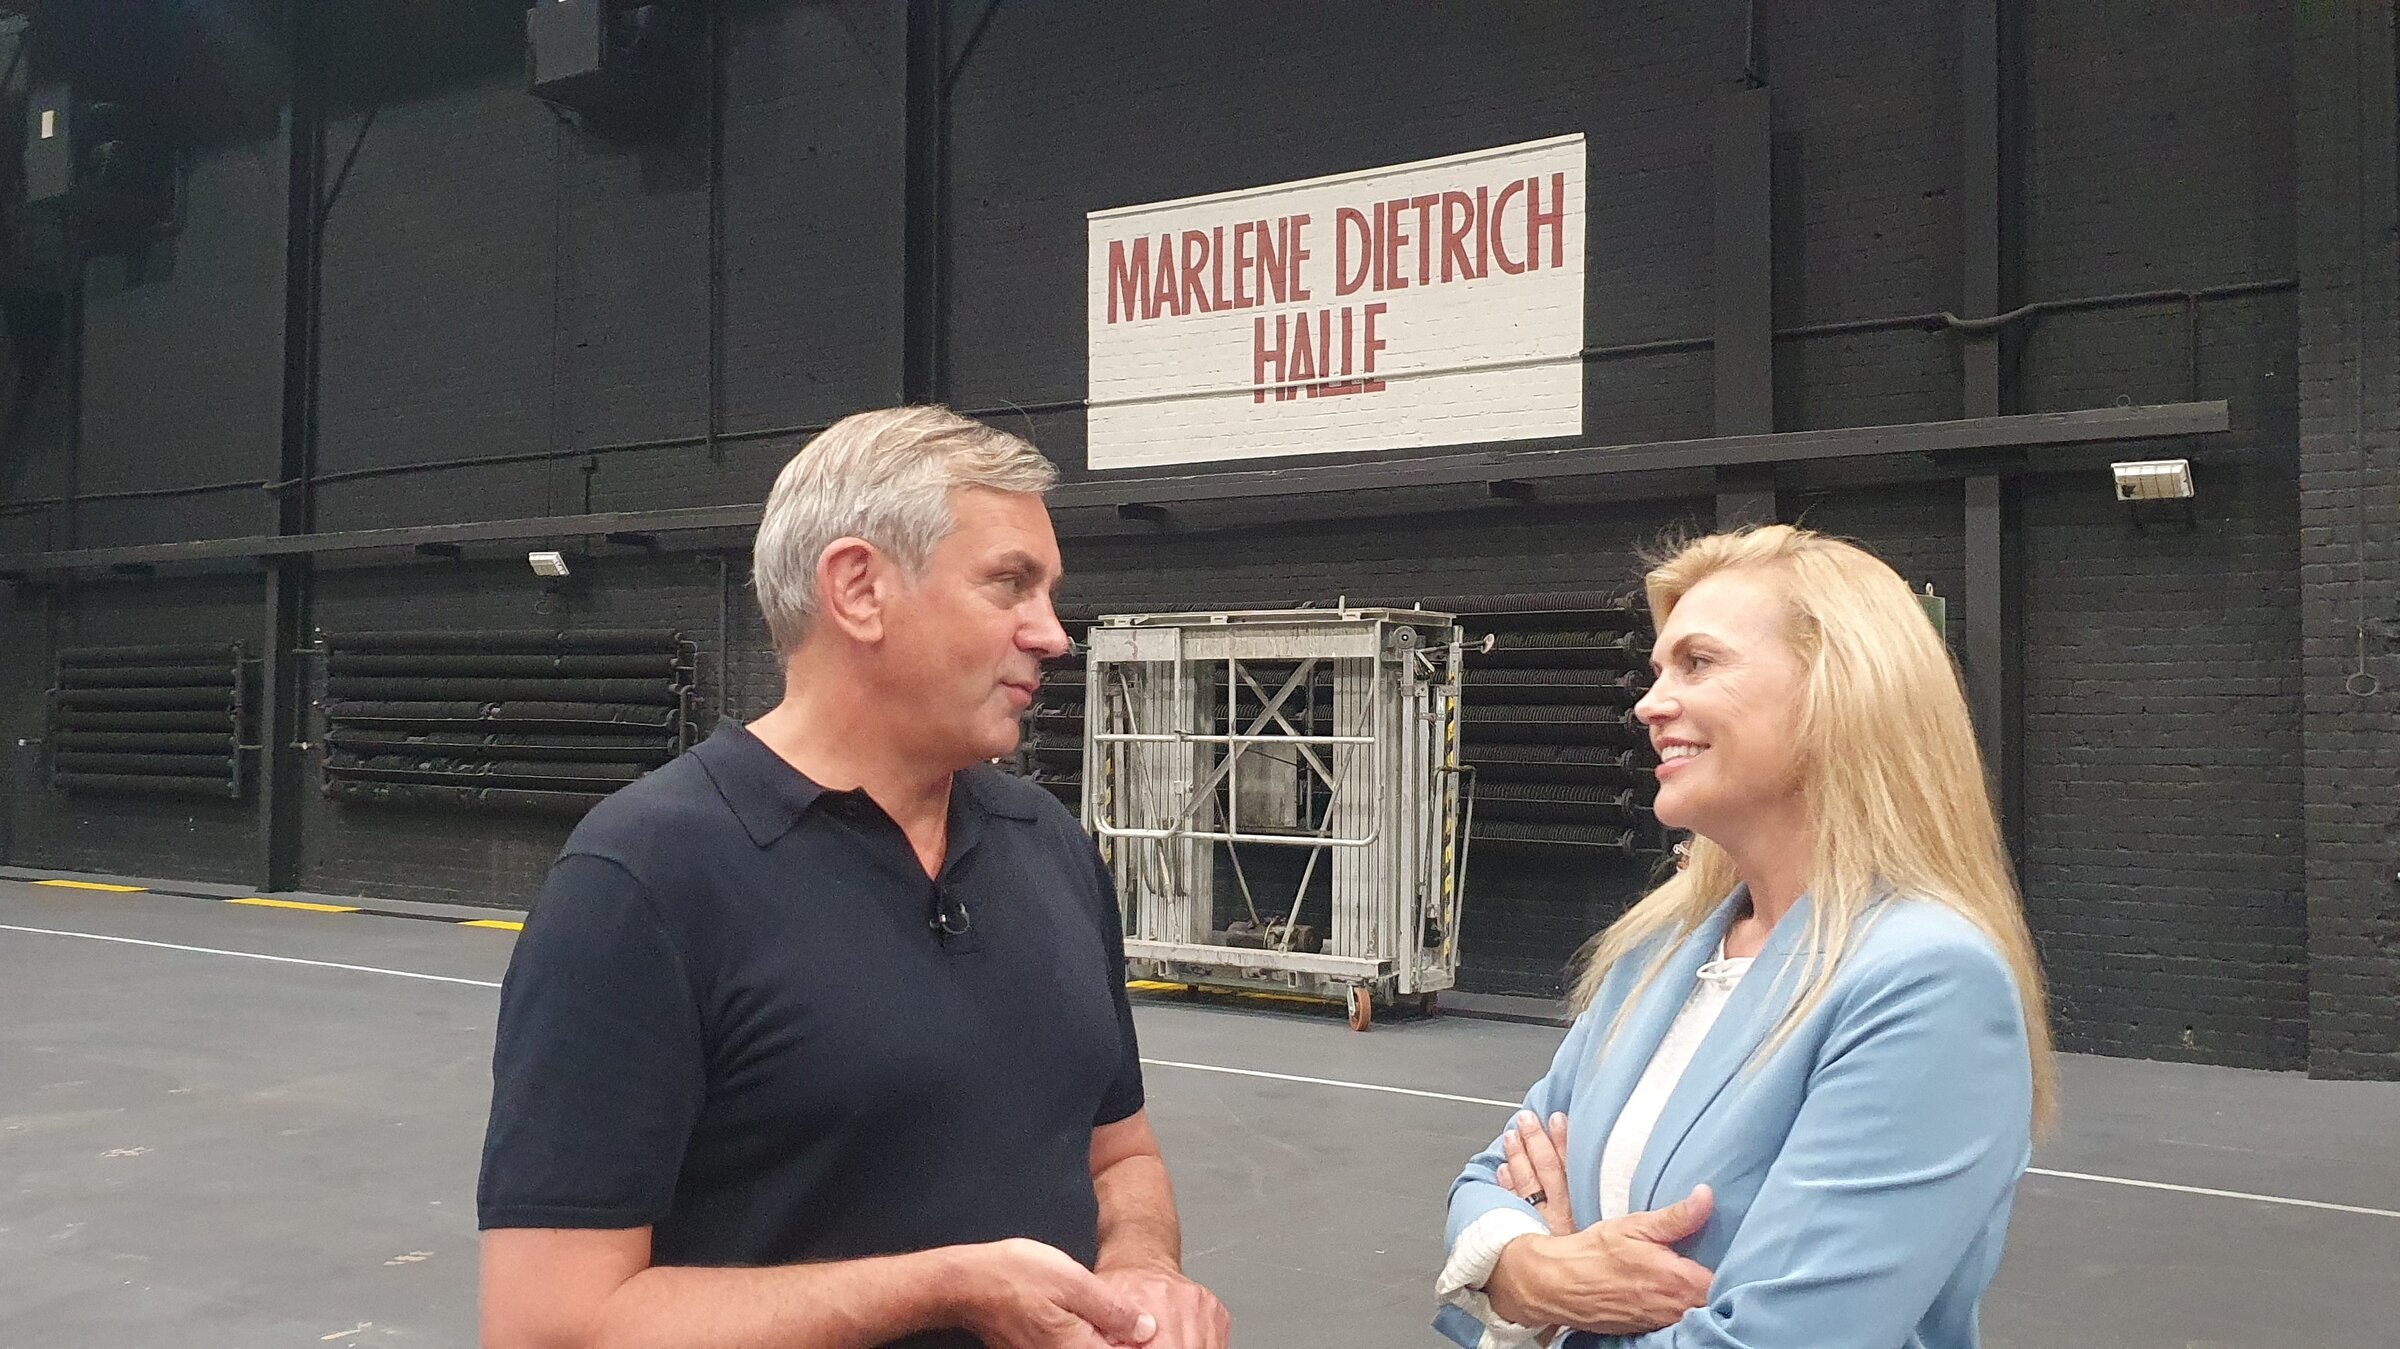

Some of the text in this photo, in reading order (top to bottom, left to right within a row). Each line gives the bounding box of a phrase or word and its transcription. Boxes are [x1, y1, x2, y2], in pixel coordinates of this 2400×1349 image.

[1107, 172, 1564, 324] MARLENE DIETRICH
[1254, 303, 1387, 404] HALLE
